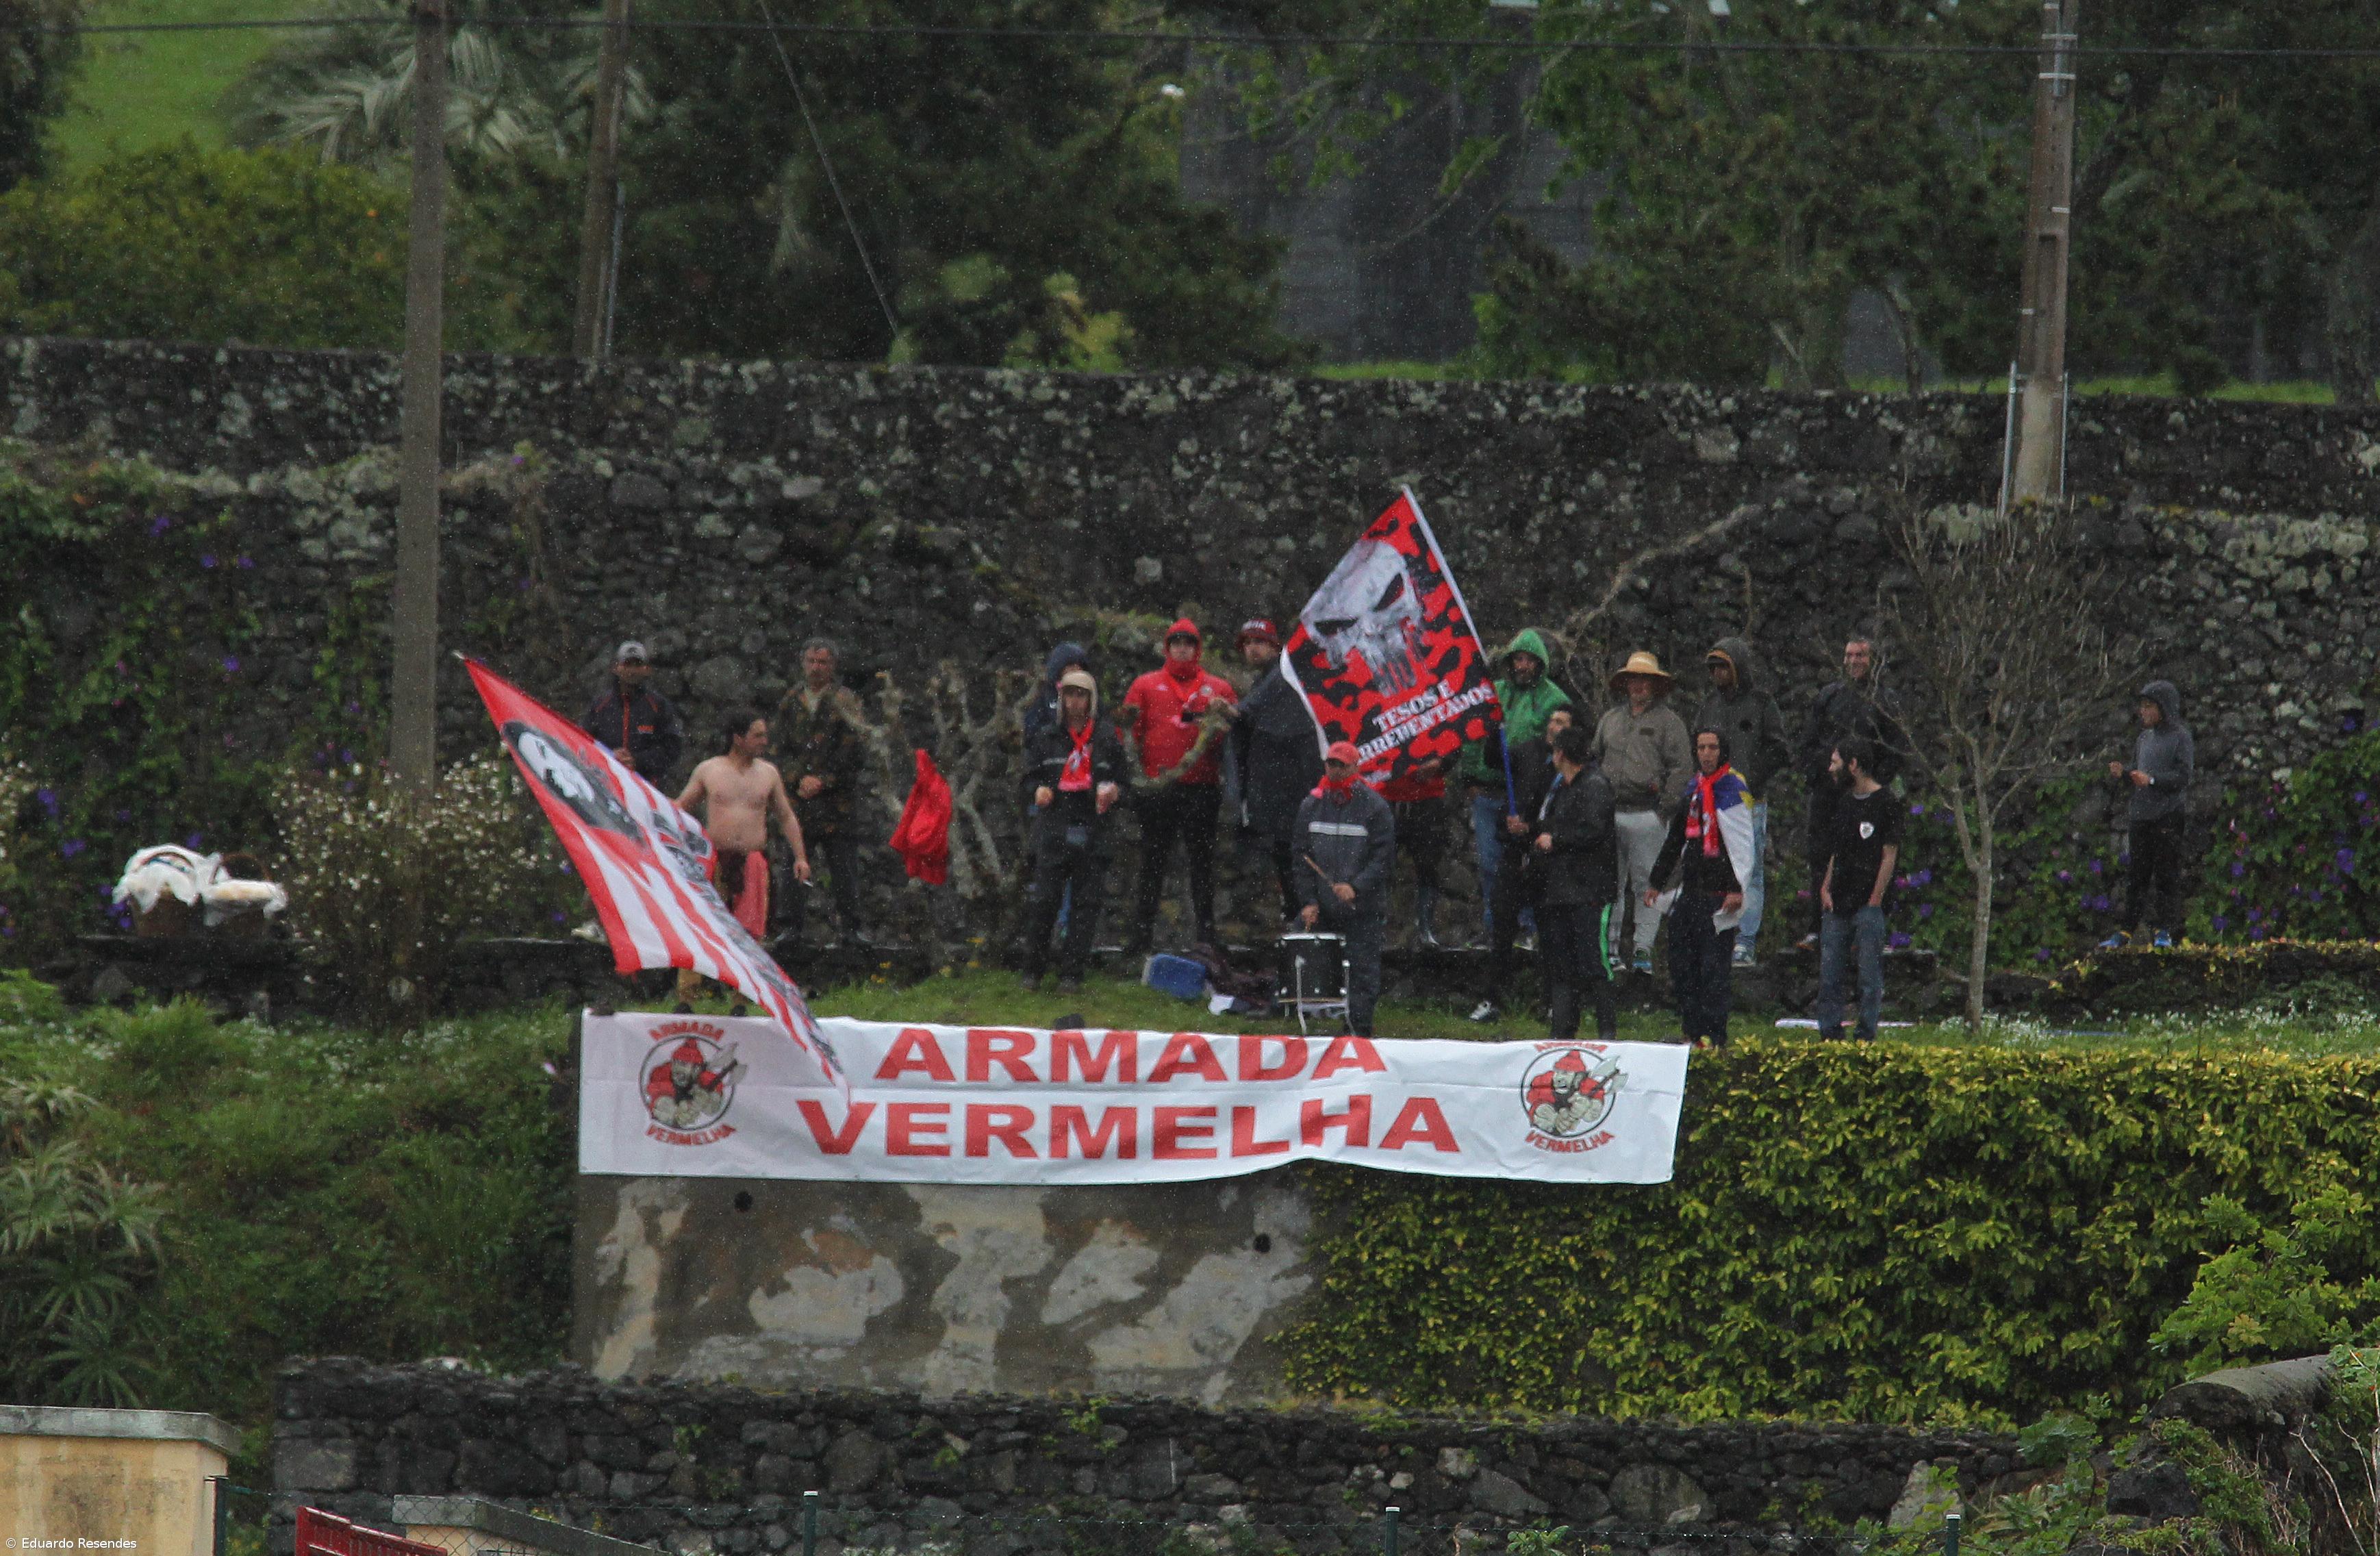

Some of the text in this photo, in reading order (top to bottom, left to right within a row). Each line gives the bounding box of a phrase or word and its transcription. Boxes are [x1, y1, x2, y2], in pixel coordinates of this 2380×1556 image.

[1357, 685, 1495, 766] RREBENTADOS
[1371, 678, 1455, 733] TESOS E
[875, 1028, 1387, 1083] ARMADA
[646, 1123, 737, 1146] VERMELHA
[798, 1094, 1460, 1159] VERMELHA
[1525, 1130, 1615, 1153] VERMELHA
